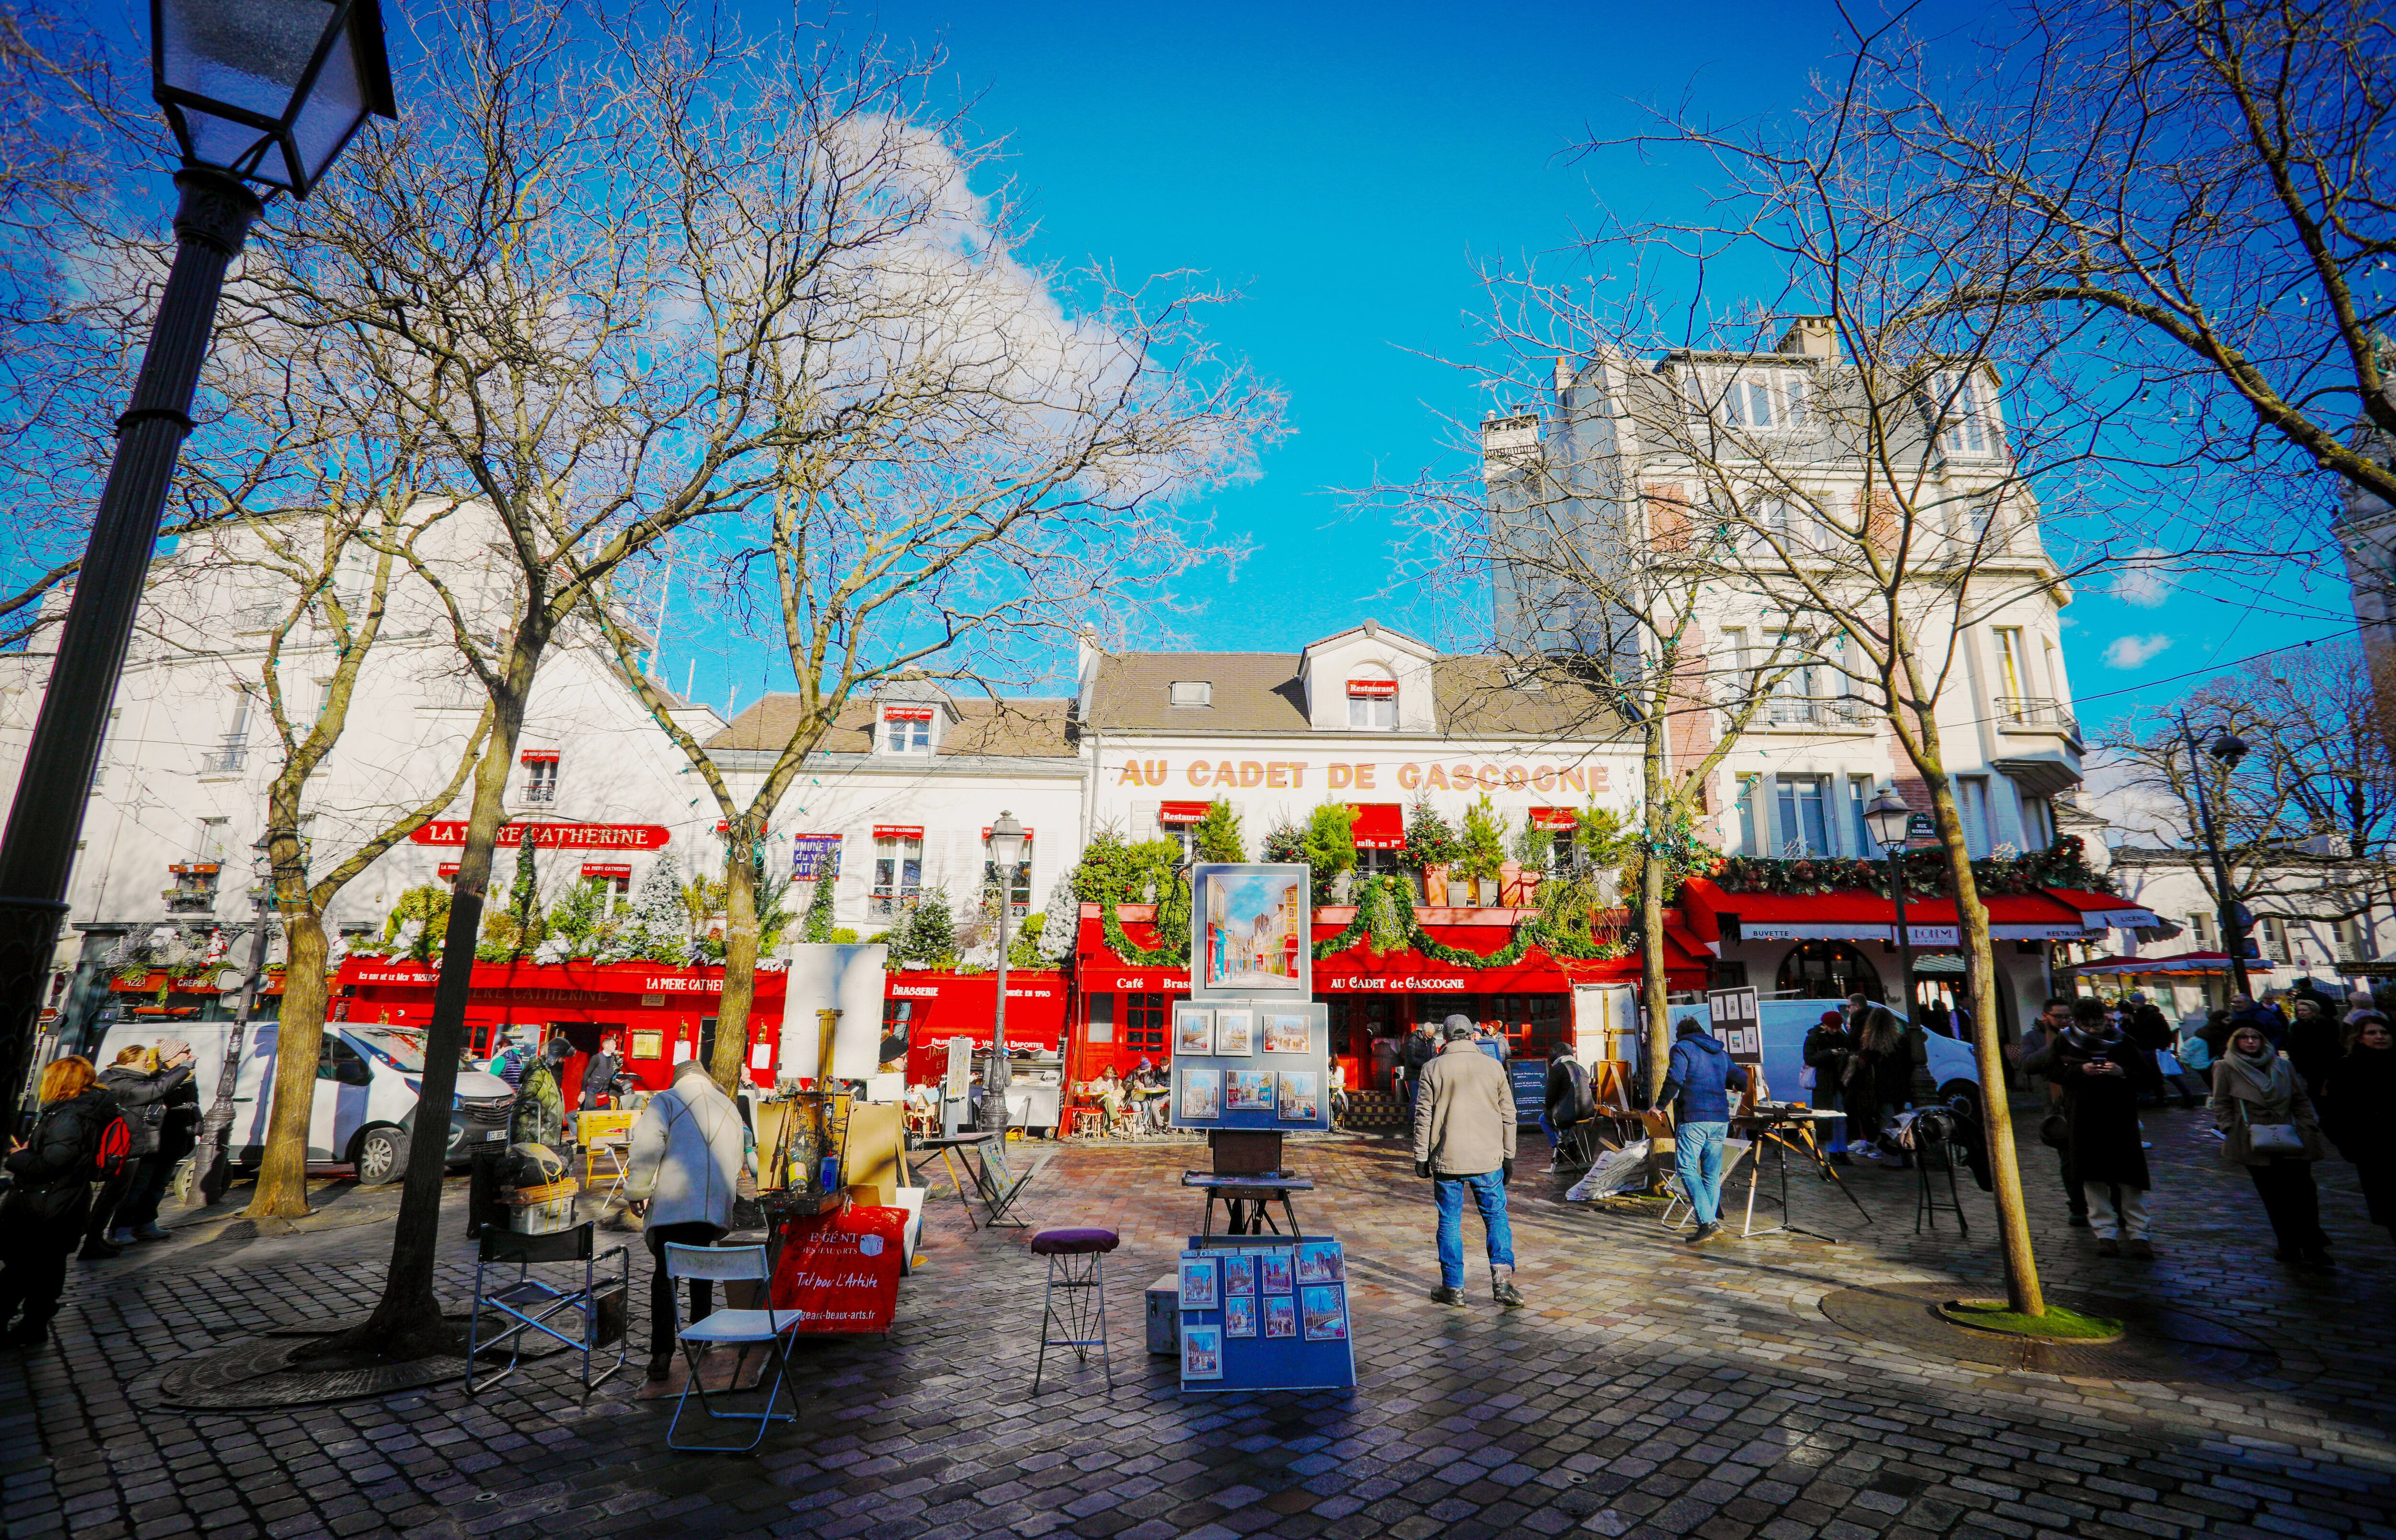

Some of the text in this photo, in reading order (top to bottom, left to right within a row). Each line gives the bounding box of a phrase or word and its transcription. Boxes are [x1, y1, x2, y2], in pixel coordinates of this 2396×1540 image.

[1349, 684, 1394, 692] Restaurant
[1117, 759, 1610, 792] AU CADET DE GASCOGNE
[1163, 812, 1208, 821] Restauran
[429, 826, 455, 840] LA
[795, 842, 824, 851] MMUNE
[1357, 839, 1375, 847] salle
[796, 851, 808, 861] du
[358, 971, 368, 979] ICI
[646, 977, 724, 991] LA MERE CATHE
[1117, 978, 1192, 988] Café Brass
[1330, 978, 1346, 988] AU
[1390, 979, 1404, 988] de
[469, 988, 608, 1002] ERE CATHERINE
[892, 984, 939, 997] BRASSERIE
[925, 1046, 949, 1060] JARD
[936, 1060, 945, 1069] ET
[836, 1272, 878, 1288] L'Artiste
